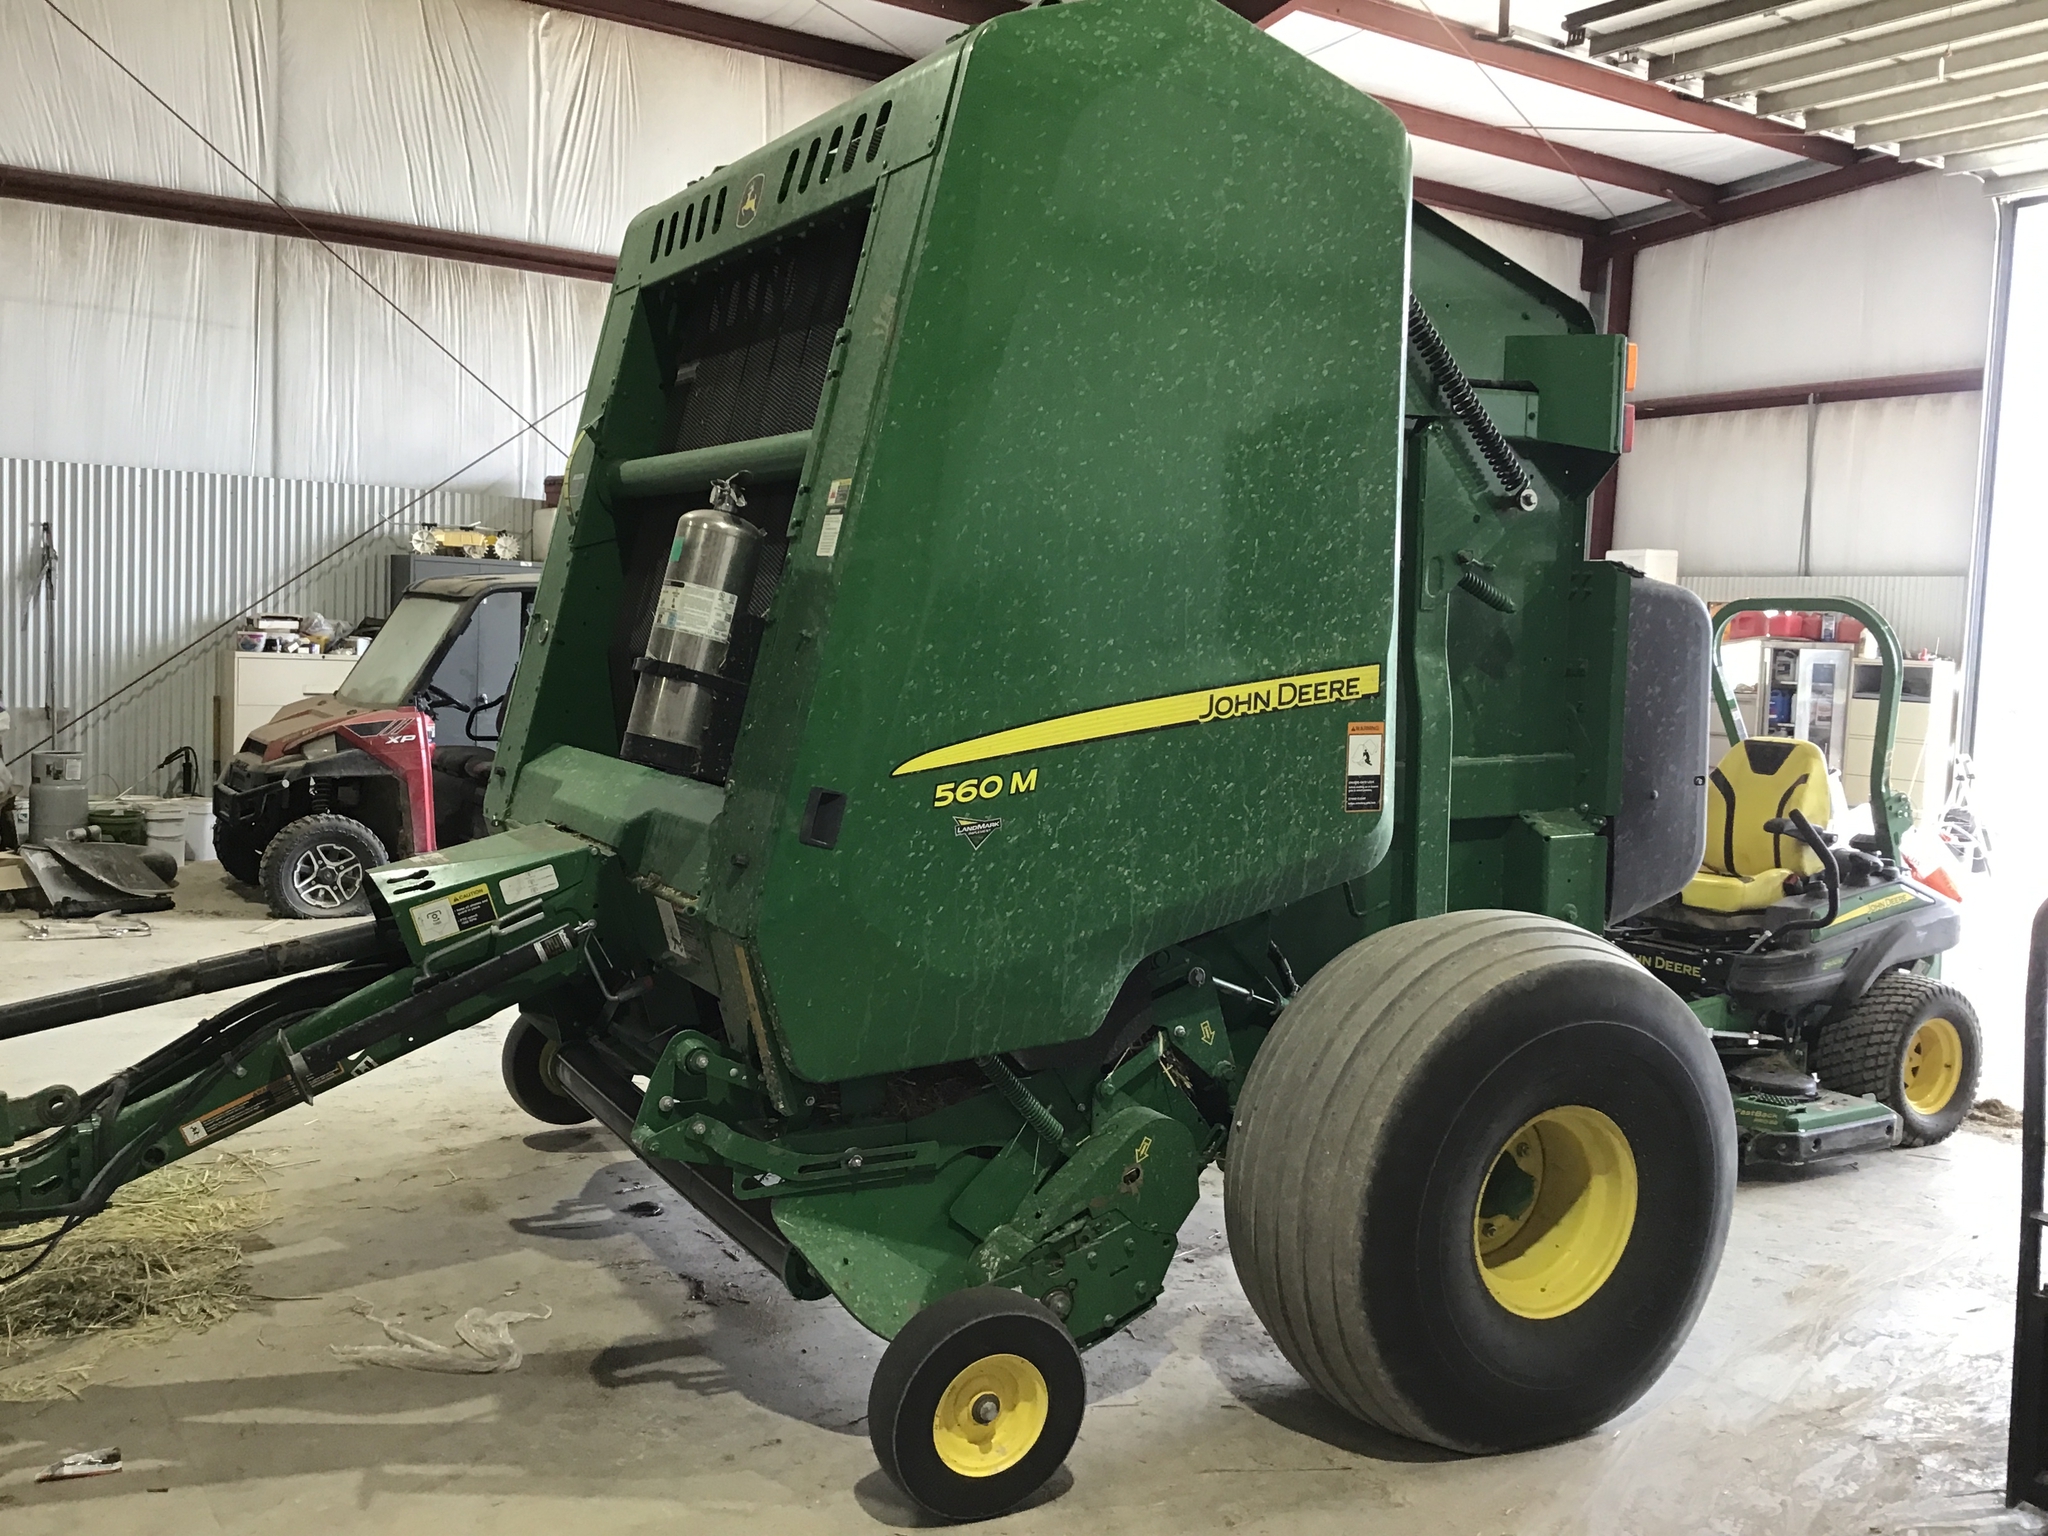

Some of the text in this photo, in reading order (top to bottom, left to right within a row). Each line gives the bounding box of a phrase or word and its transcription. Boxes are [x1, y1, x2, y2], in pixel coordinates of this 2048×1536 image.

[1198, 677, 1361, 720] JOHN DEERE
[384, 734, 417, 745] XP
[934, 768, 1038, 807] 560 M
[957, 821, 1000, 833] LANDMARK
[458, 888, 484, 900] CAUTION
[1654, 955, 1702, 978] DEERE
